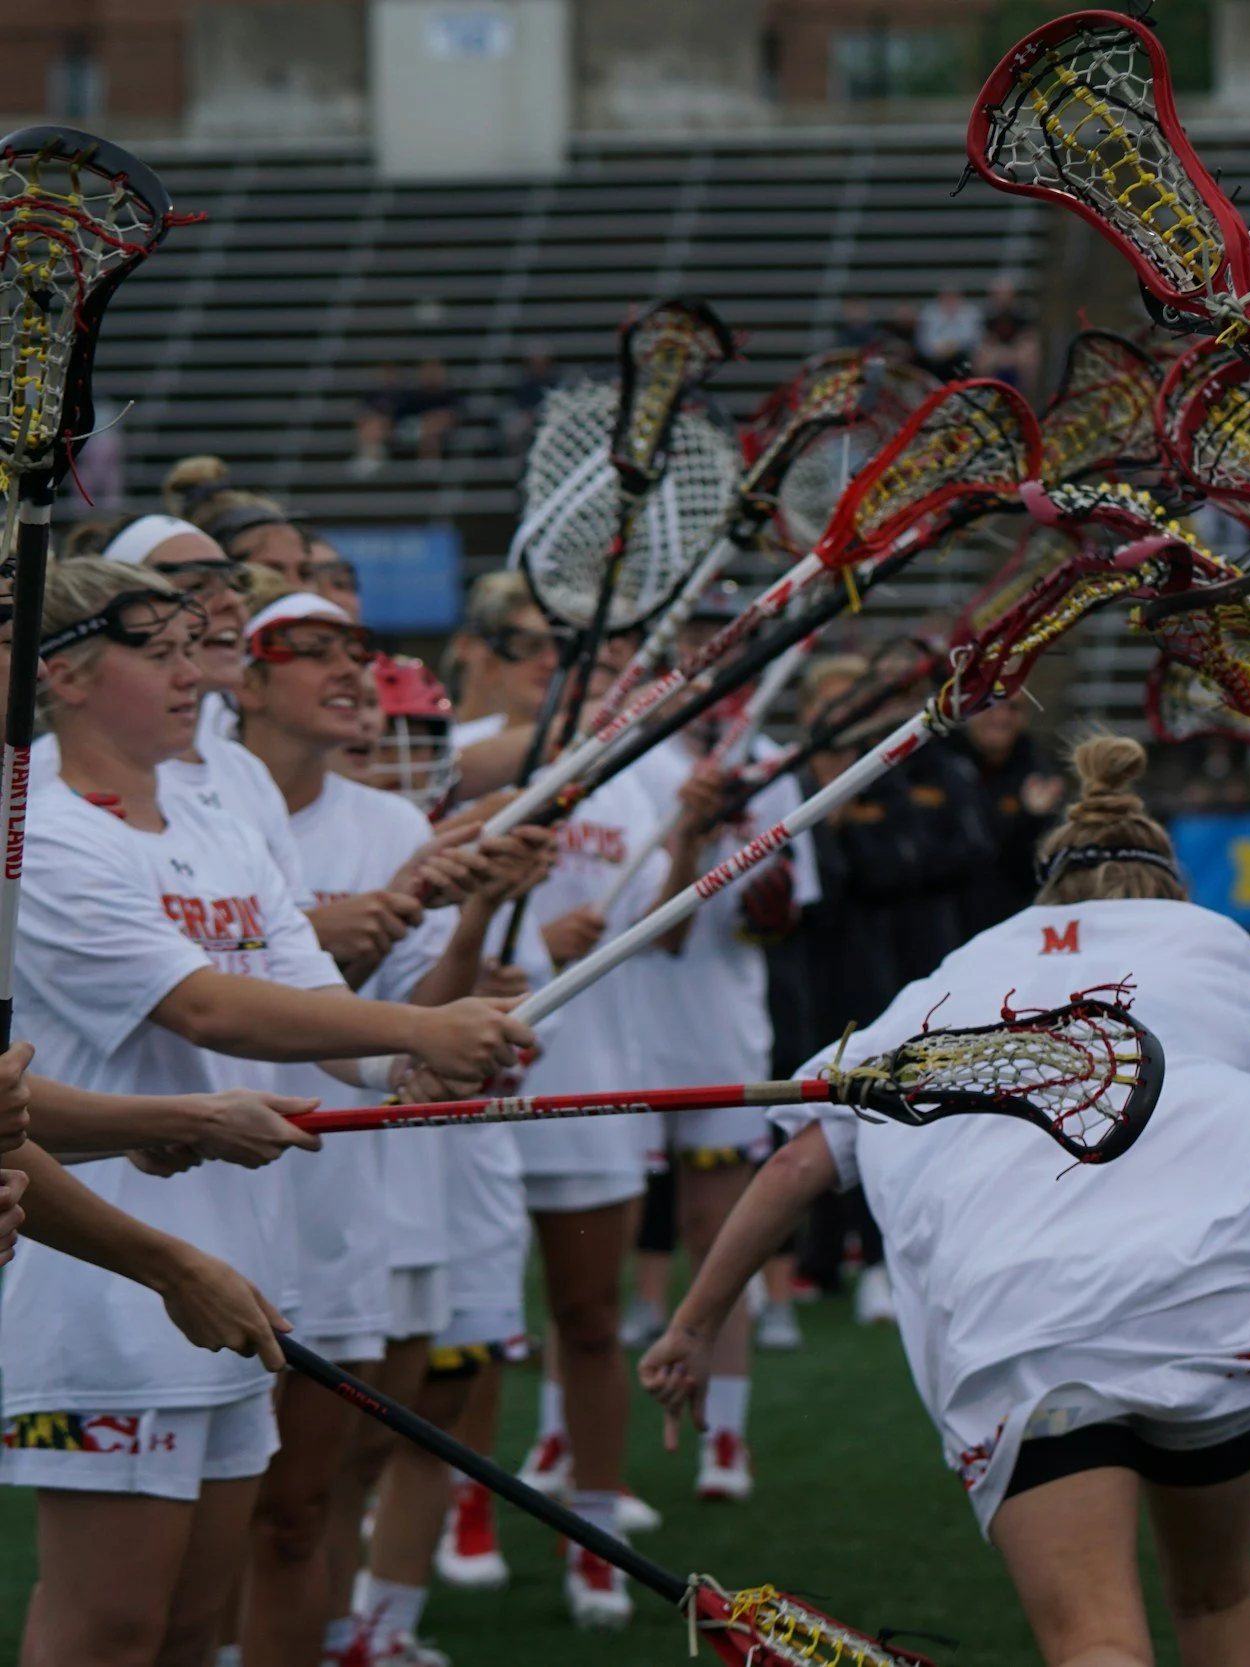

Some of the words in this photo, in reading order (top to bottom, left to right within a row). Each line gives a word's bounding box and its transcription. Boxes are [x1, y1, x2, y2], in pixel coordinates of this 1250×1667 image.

[5, 744, 31, 880] MARYLAND
[695, 822, 791, 899] MARYLAND
[1038, 920, 1081, 955] M
